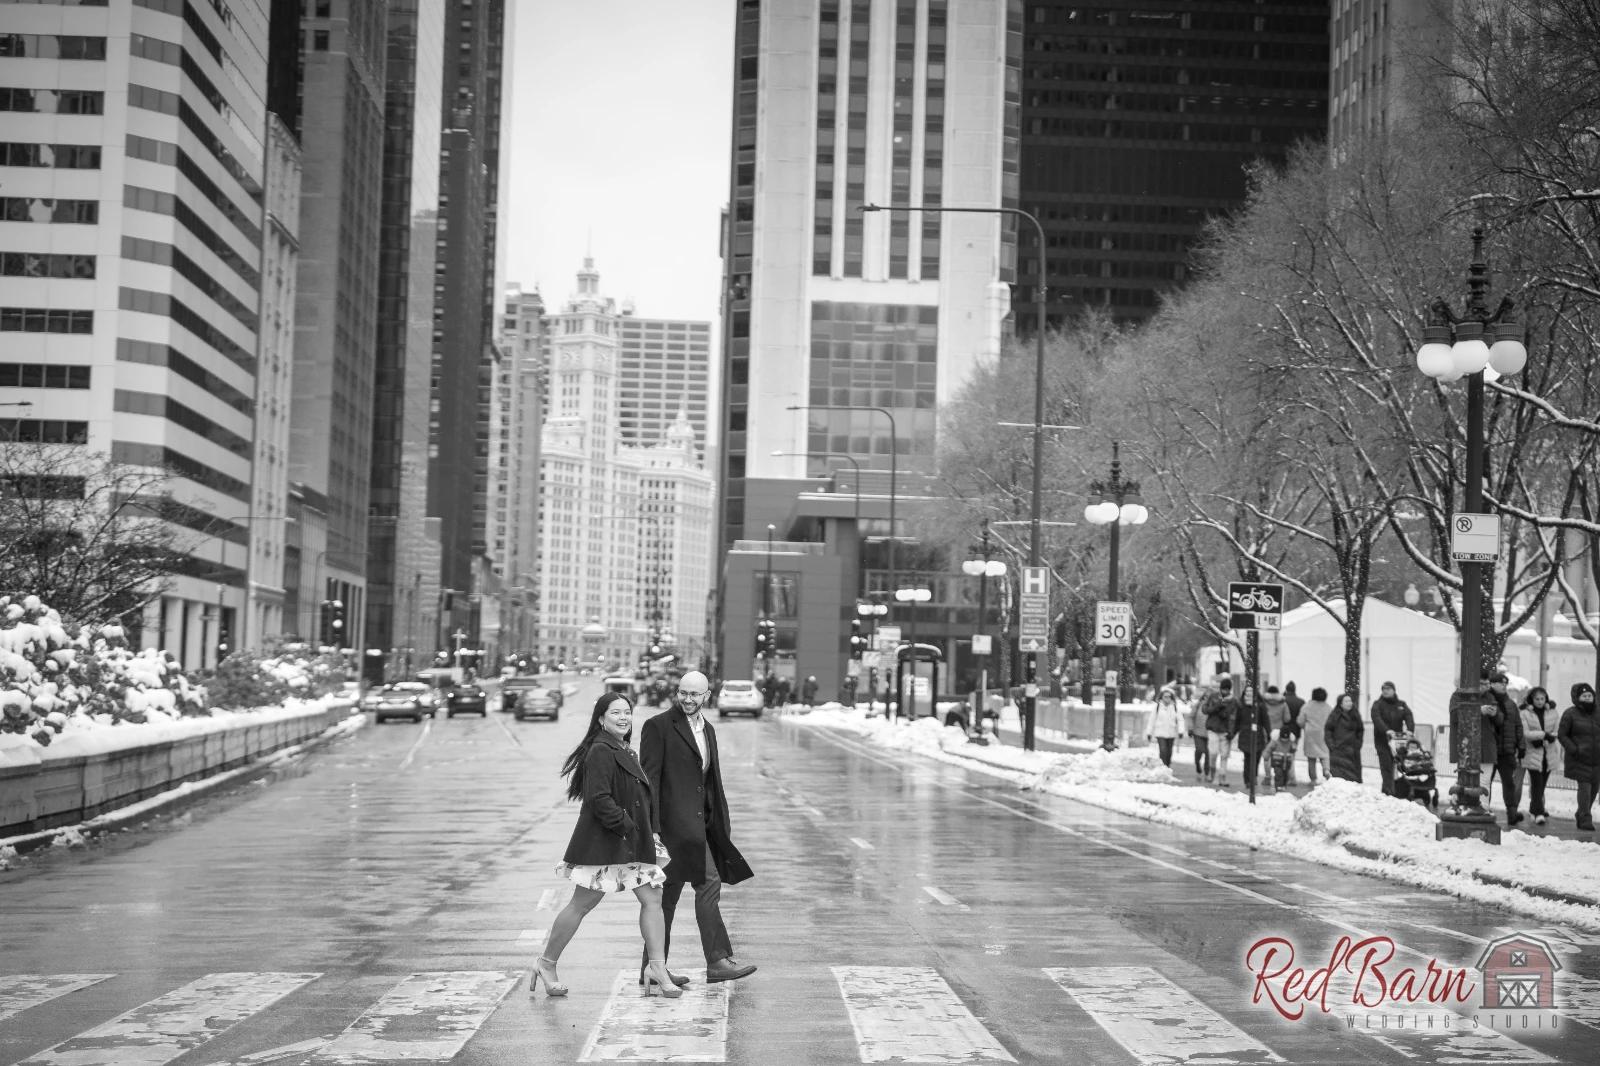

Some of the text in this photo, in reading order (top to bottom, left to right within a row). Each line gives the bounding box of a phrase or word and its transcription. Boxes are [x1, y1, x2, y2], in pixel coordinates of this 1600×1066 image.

[1455, 552, 1471, 560] TOW
[1024, 568, 1046, 594] H
[1100, 605, 1128, 614] SPEED
[1101, 624, 1126, 639] 30
